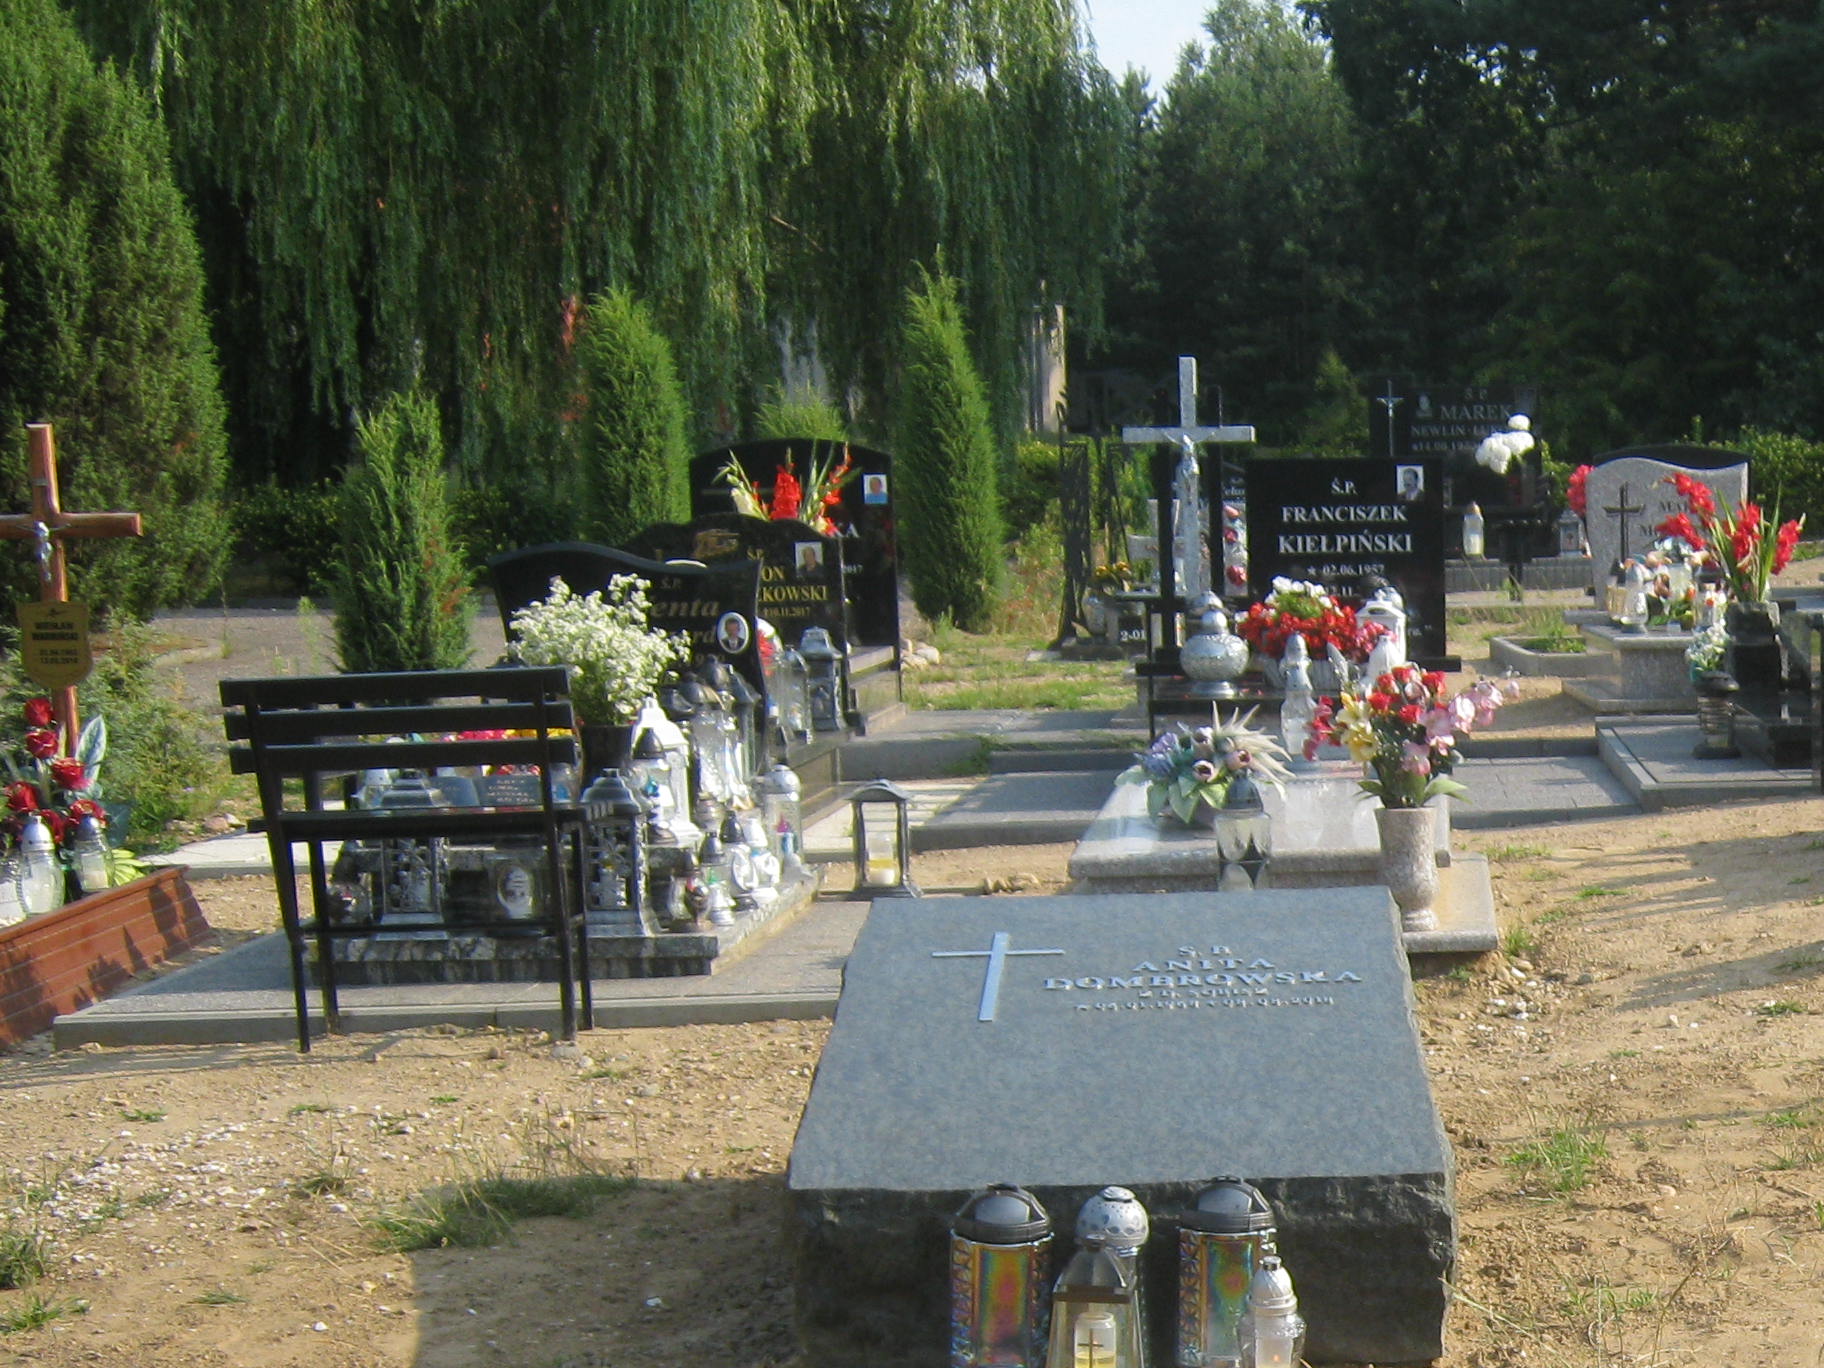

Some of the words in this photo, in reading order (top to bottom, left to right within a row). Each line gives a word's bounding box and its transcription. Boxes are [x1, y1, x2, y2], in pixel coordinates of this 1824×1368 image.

[1330, 476, 1358, 496] Ś.P.
[1281, 504, 1409, 523] FRANCISZEK
[757, 585, 830, 603] KOWSKI
[1131, 957, 1276, 973] ANITA
[1044, 970, 1363, 991] DOMBROWSKA
